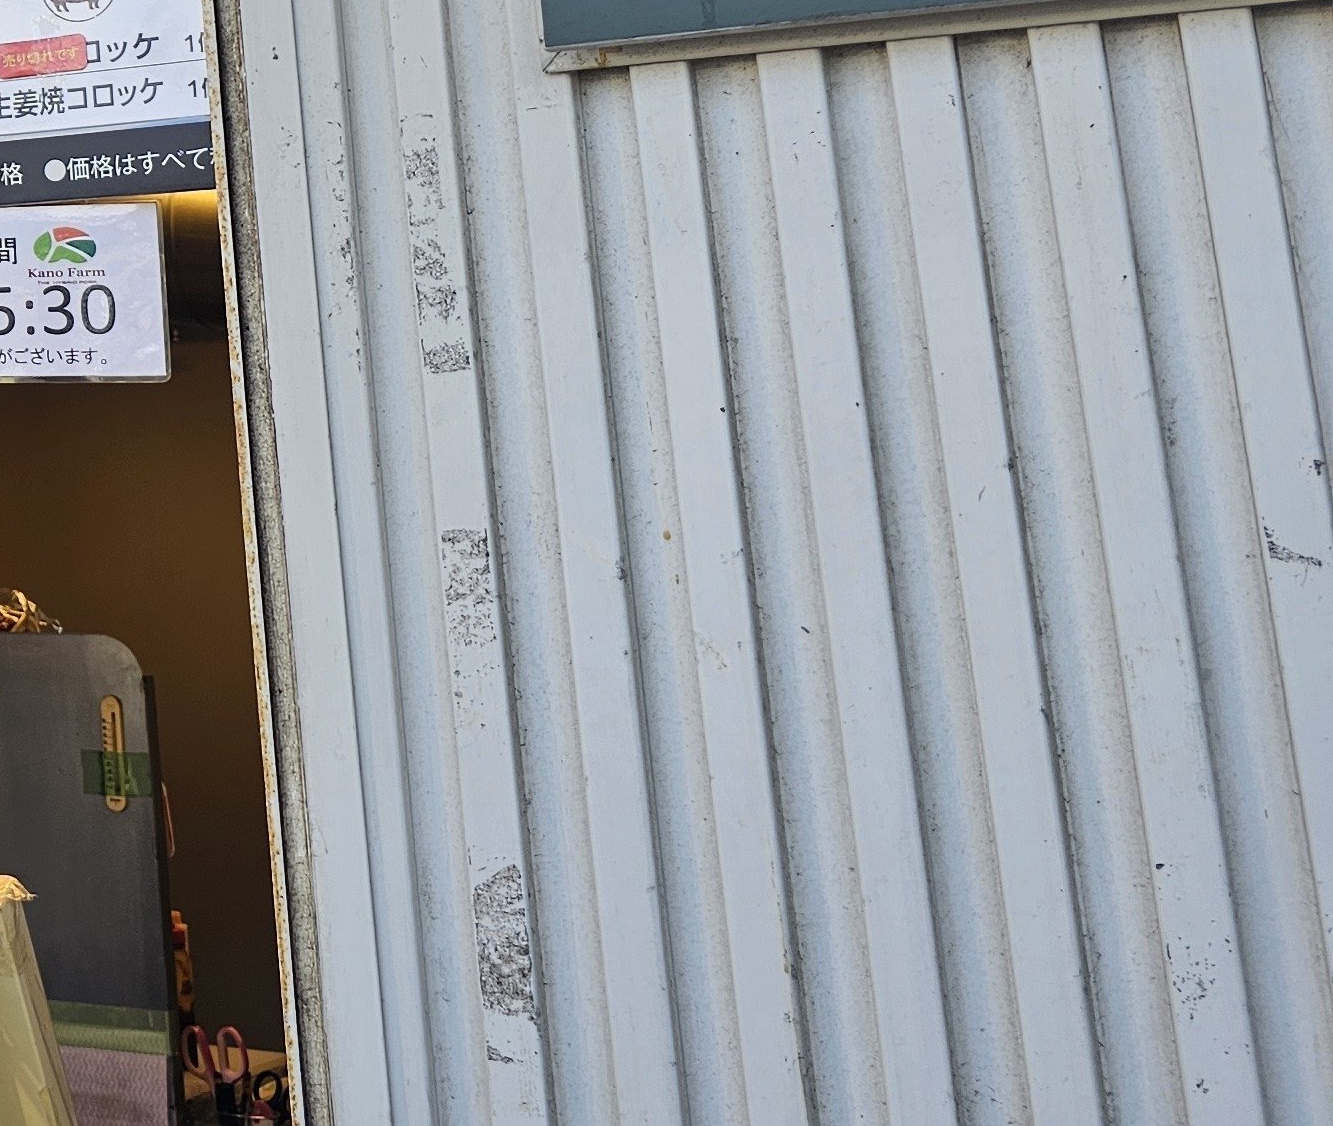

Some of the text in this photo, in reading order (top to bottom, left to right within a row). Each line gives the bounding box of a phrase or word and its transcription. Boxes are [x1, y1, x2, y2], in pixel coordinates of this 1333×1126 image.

[66, 147, 213, 181] 価格はすべて
[28, 267, 105, 278] Kano Farm
